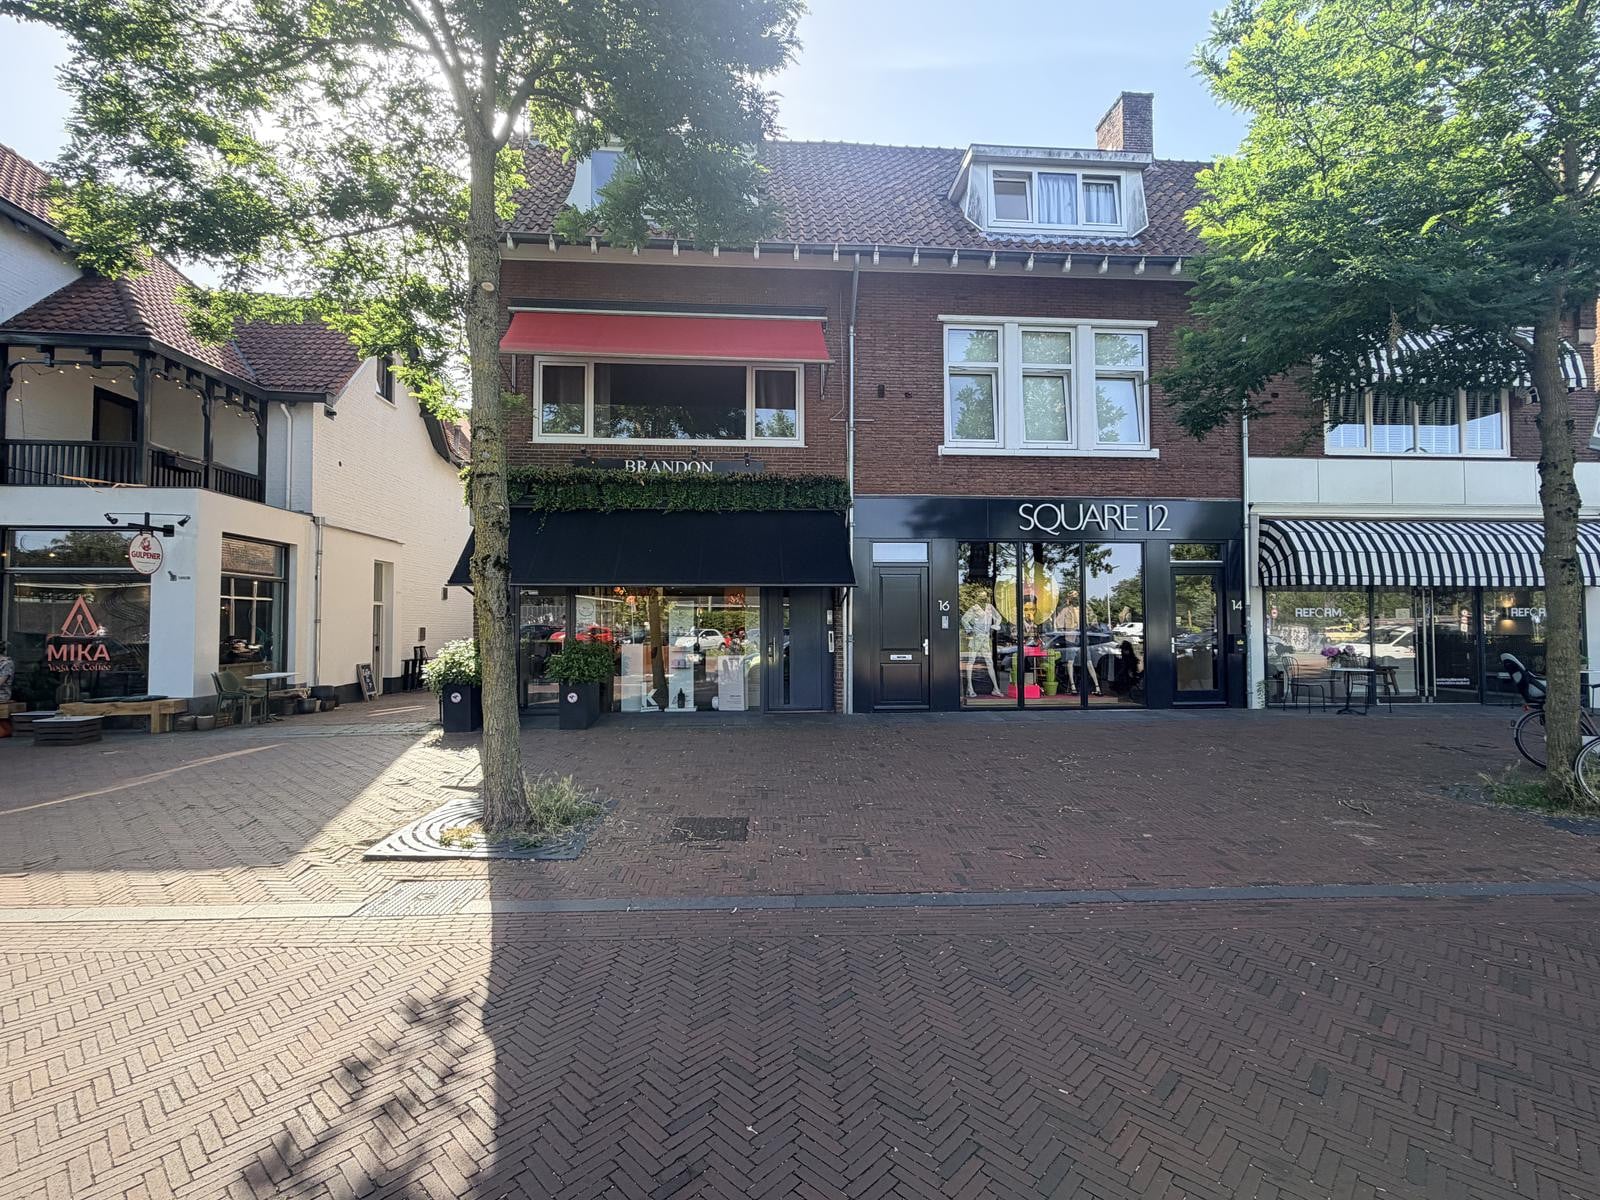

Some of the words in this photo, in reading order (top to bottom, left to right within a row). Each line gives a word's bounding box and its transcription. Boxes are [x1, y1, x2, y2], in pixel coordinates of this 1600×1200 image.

[624, 459, 714, 474] BRANDON
[1018, 503, 1139, 536] SQUARE
[1148, 503, 1172, 531] 12
[131, 550, 161, 560] GULPENER
[937, 599, 950, 611] 16
[1231, 599, 1243, 611] 14
[1295, 606, 1342, 619] REFORM
[1510, 606, 1546, 618] REFOR
[47, 643, 111, 662] MIKA
[48, 663, 70, 672] Yoga
[71, 663, 80, 671] &
[82, 663, 112, 671] Coffee
